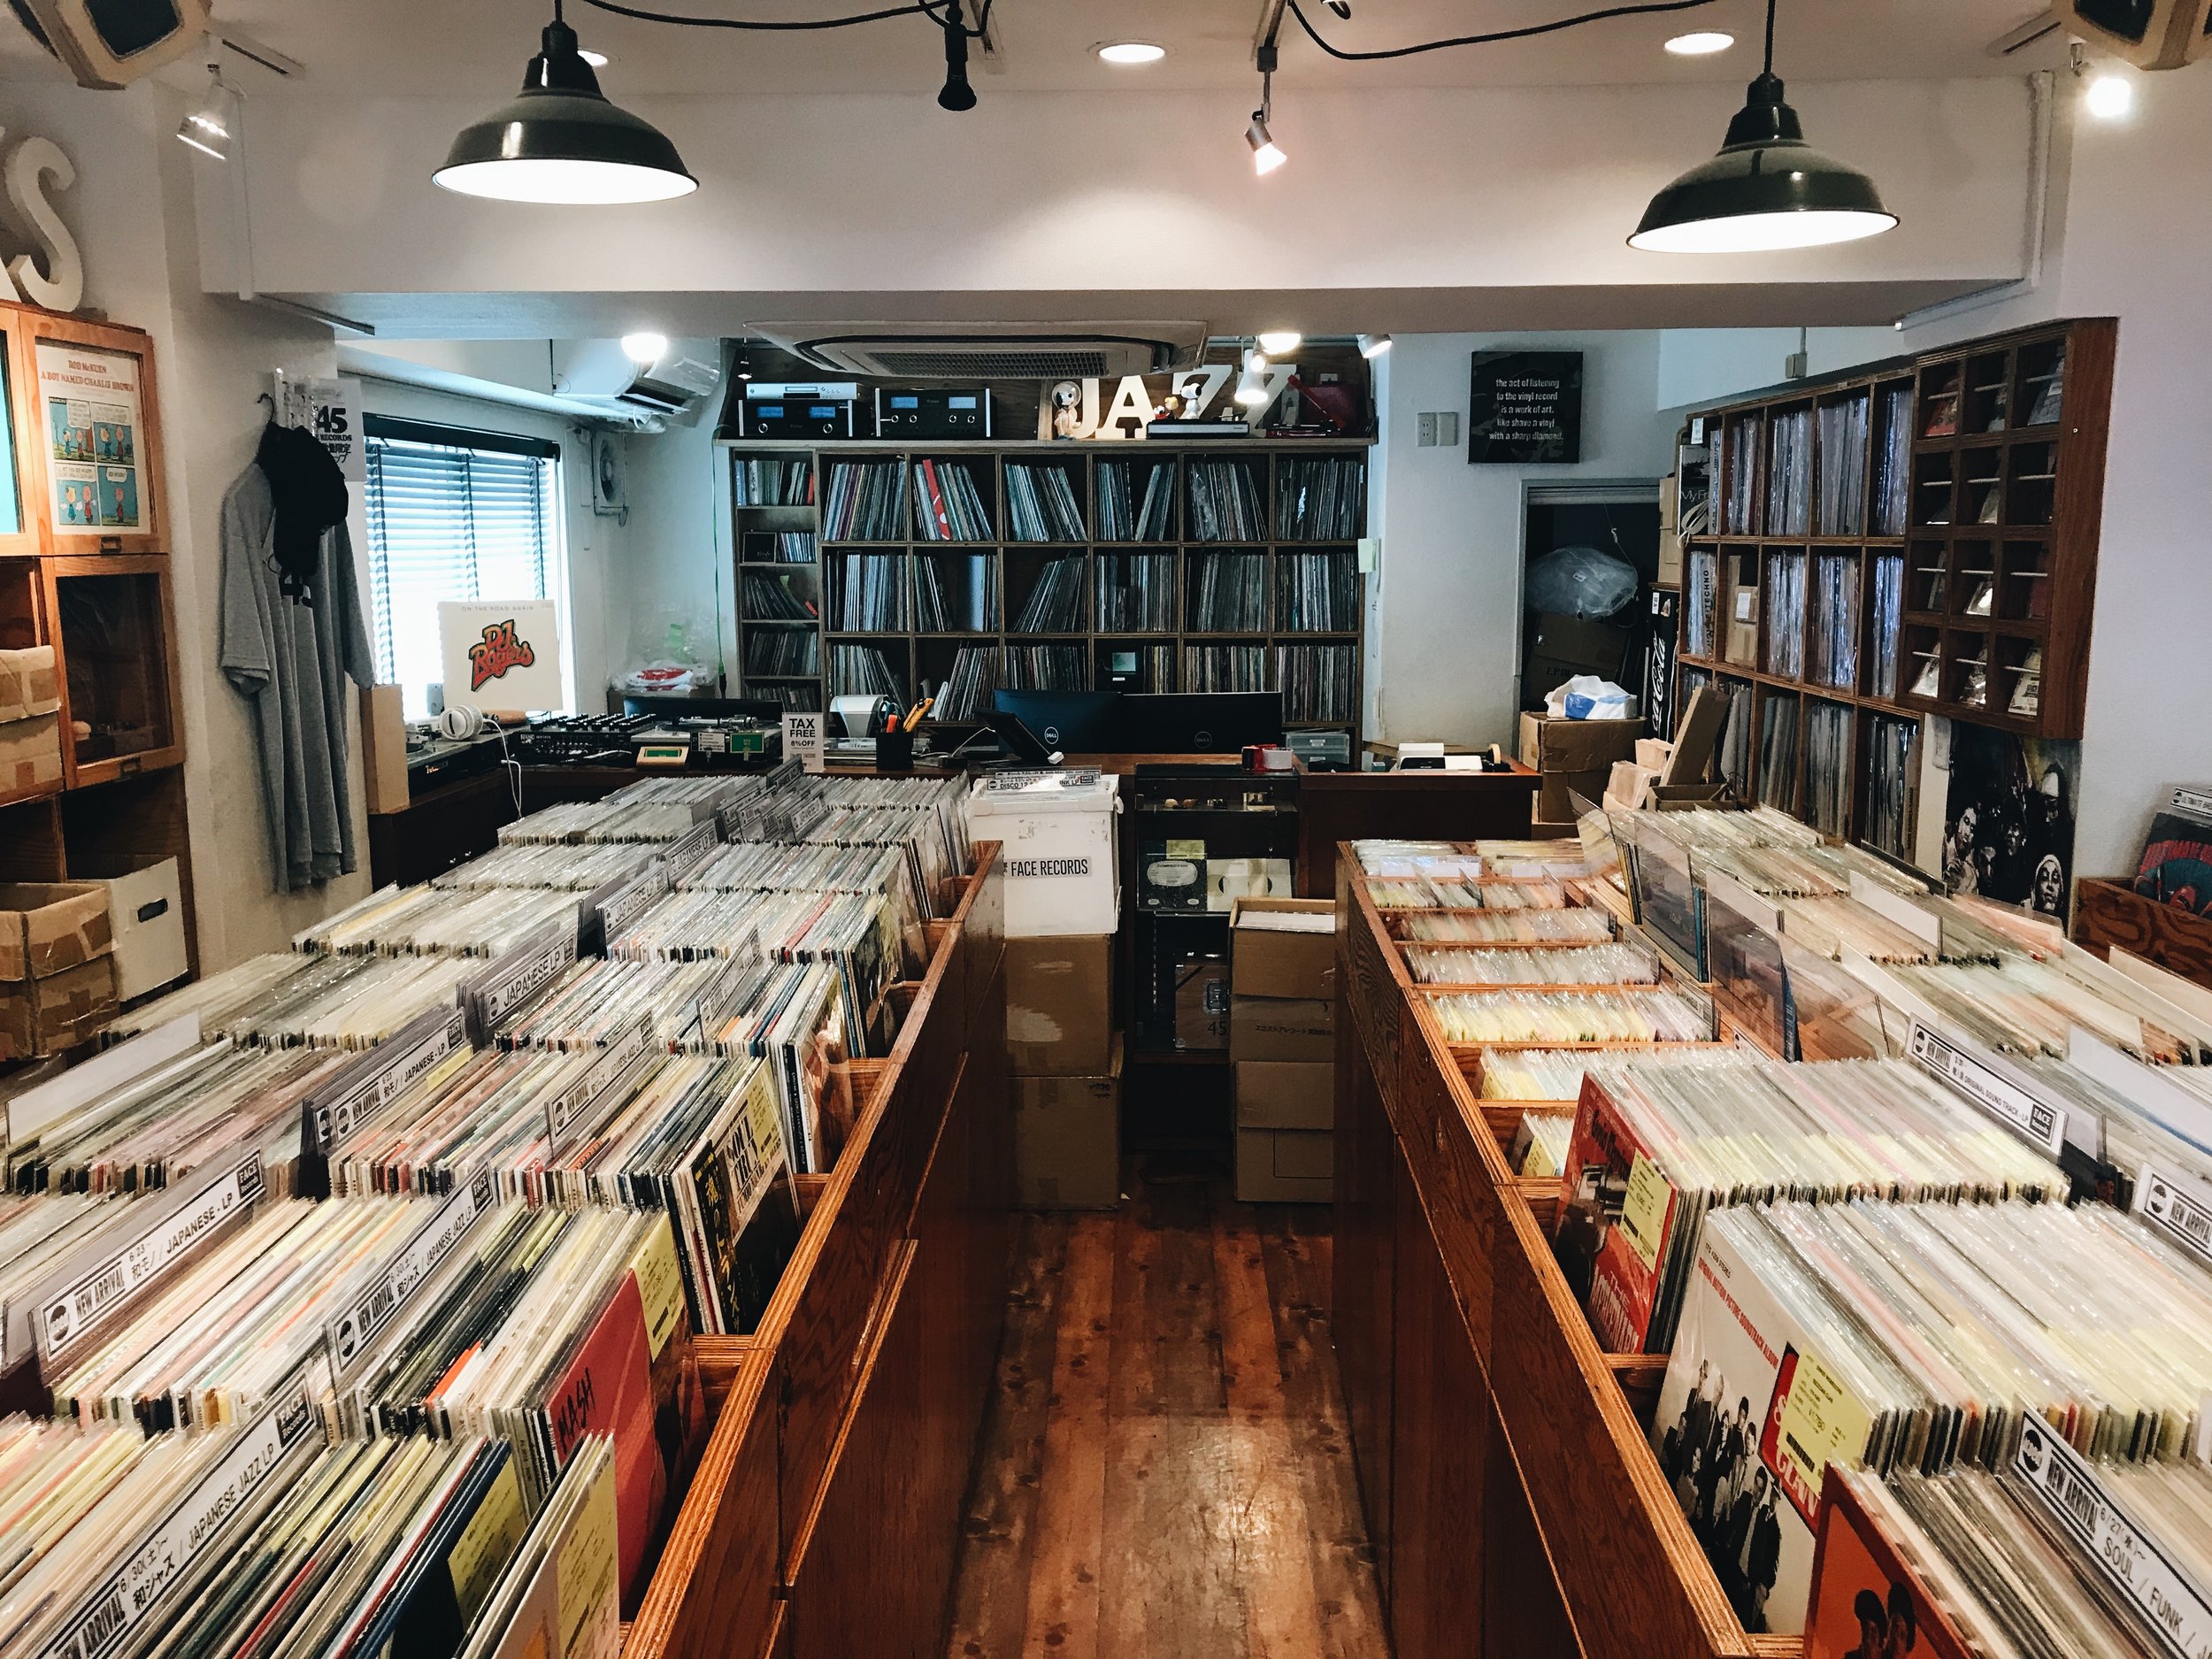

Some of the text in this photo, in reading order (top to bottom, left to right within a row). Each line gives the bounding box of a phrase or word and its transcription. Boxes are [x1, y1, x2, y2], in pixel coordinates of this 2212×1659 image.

[0, 135, 83, 312] S
[1067, 364, 1297, 440] JAZZ
[1495, 379, 1560, 389] the act of listening
[1496, 392, 1558, 402] to the vinyl record
[317, 405, 348, 434] 45
[1511, 432, 1531, 442] sharp
[1539, 419, 1555, 428] vinyl
[788, 718, 815, 729] TAX
[789, 729, 816, 738] FREE
[1010, 860, 1037, 877] FACE
[1040, 858, 1088, 876] RECORDS
[503, 951, 560, 1007] JAPANESE LP
[404, 1051, 434, 1083] JAPANESE
[438, 1042, 446, 1056] LP
[363, 1087, 380, 1115] ARRIVAL
[1963, 1074, 1985, 1095] ORIGINAL
[1985, 1090, 2002, 1106] SOUND
[2002, 1100, 2019, 1118] TRACK
[2033, 1109, 2052, 1125] FACE
[238, 1162, 257, 1184] FACE
[473, 1174, 488, 1195] FACE
[166, 1206, 216, 1254] JAPANESE
[221, 1192, 233, 1210] LP
[426, 1227, 452, 1266] JAPANESE
[453, 1213, 465, 1236] JAZZ
[466, 1205, 472, 1222] LP
[74, 1266, 125, 1319] NEW ARRIVAL
[357, 1280, 394, 1335] NEW ARRIVAL
[280, 1394, 304, 1426] FACE
[282, 1408, 306, 1440] Records
[558, 1367, 596, 1455] MASH
[2047, 1457, 2099, 1534] NEW ARRIVAL
[133, 1550, 175, 1611] 和ジャズ
[188, 1484, 237, 1550] JAPANESE
[238, 1457, 262, 1494] JAZZ
[263, 1442, 273, 1466] LP
[2104, 1536, 2134, 1584] SOUL
[2149, 1586, 2184, 1638] FUNK
[81, 1592, 126, 1658] ARRIVAL
